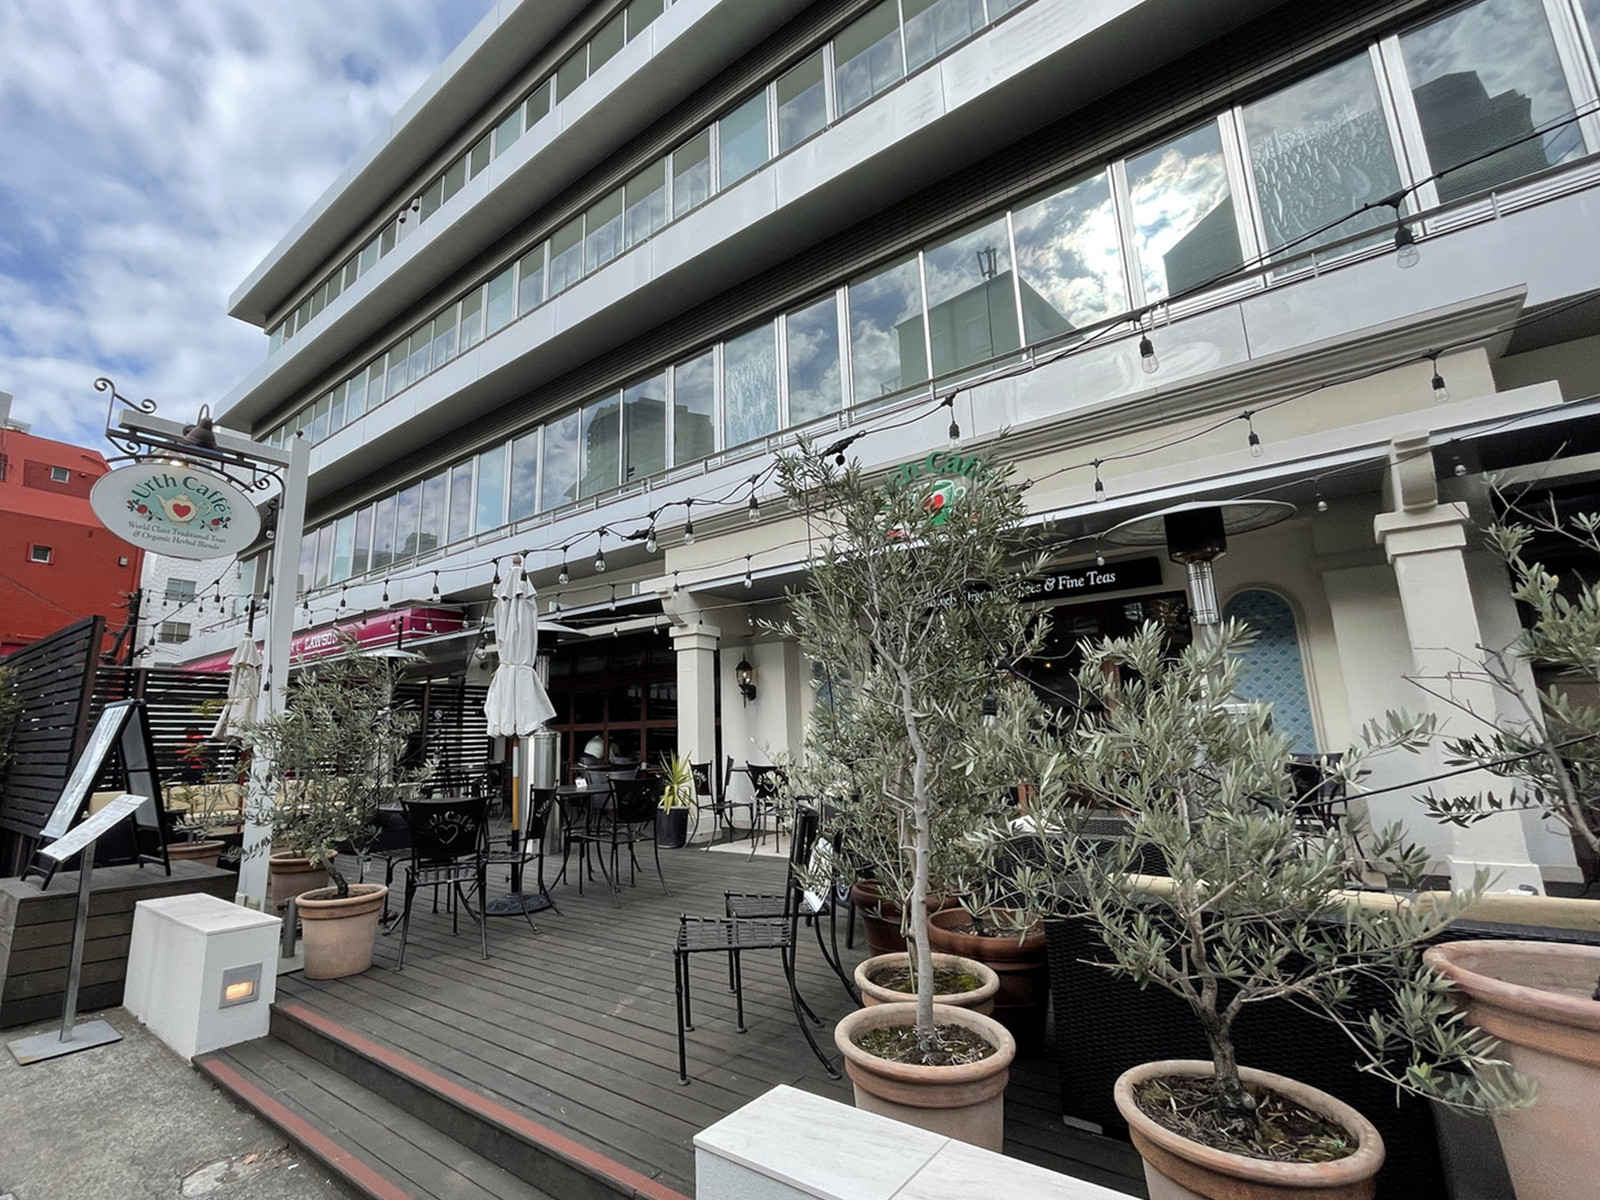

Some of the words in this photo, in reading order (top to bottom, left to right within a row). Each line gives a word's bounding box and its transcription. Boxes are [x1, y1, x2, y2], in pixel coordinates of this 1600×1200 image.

[131, 473, 178, 499] Urth
[182, 476, 232, 514] Caffé
[128, 521, 150, 531] World
[151, 525, 170, 534] Class
[173, 528, 209, 540] Traditional
[211, 534, 226, 543] Teas
[142, 532, 171, 542] Organic
[173, 536, 197, 547] Herbal
[197, 540, 220, 550] Blends
[1044, 576, 1056, 591] &
[1058, 574, 1084, 590] Fine
[1086, 571, 1116, 586] Teas
